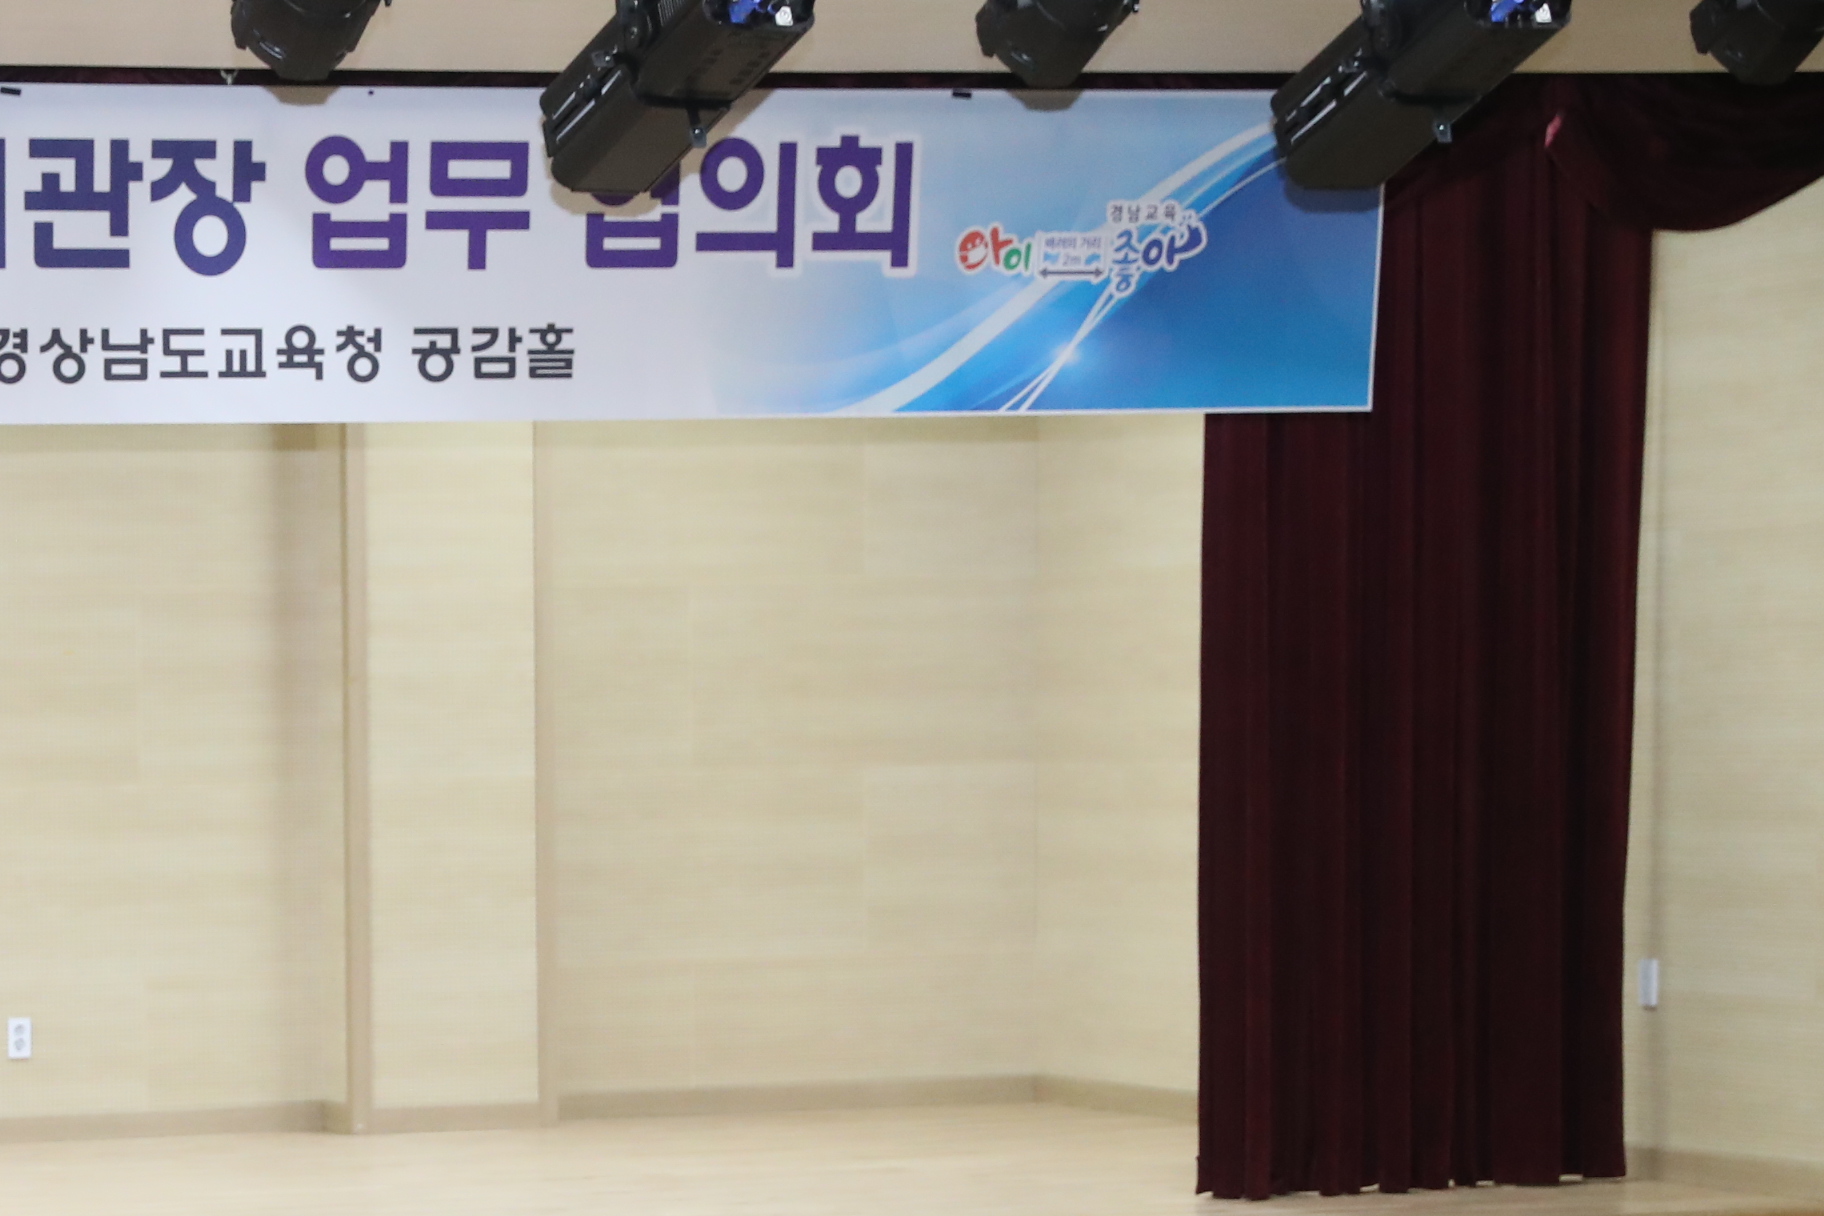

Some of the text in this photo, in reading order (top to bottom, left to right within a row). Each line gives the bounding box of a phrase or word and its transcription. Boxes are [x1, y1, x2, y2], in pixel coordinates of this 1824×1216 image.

[305, 135, 531, 270] 업무
[1111, 204, 1176, 223] 경남교육
[959, 223, 1205, 292] 아이 좋아
[411, 322, 575, 383] 공감홀
